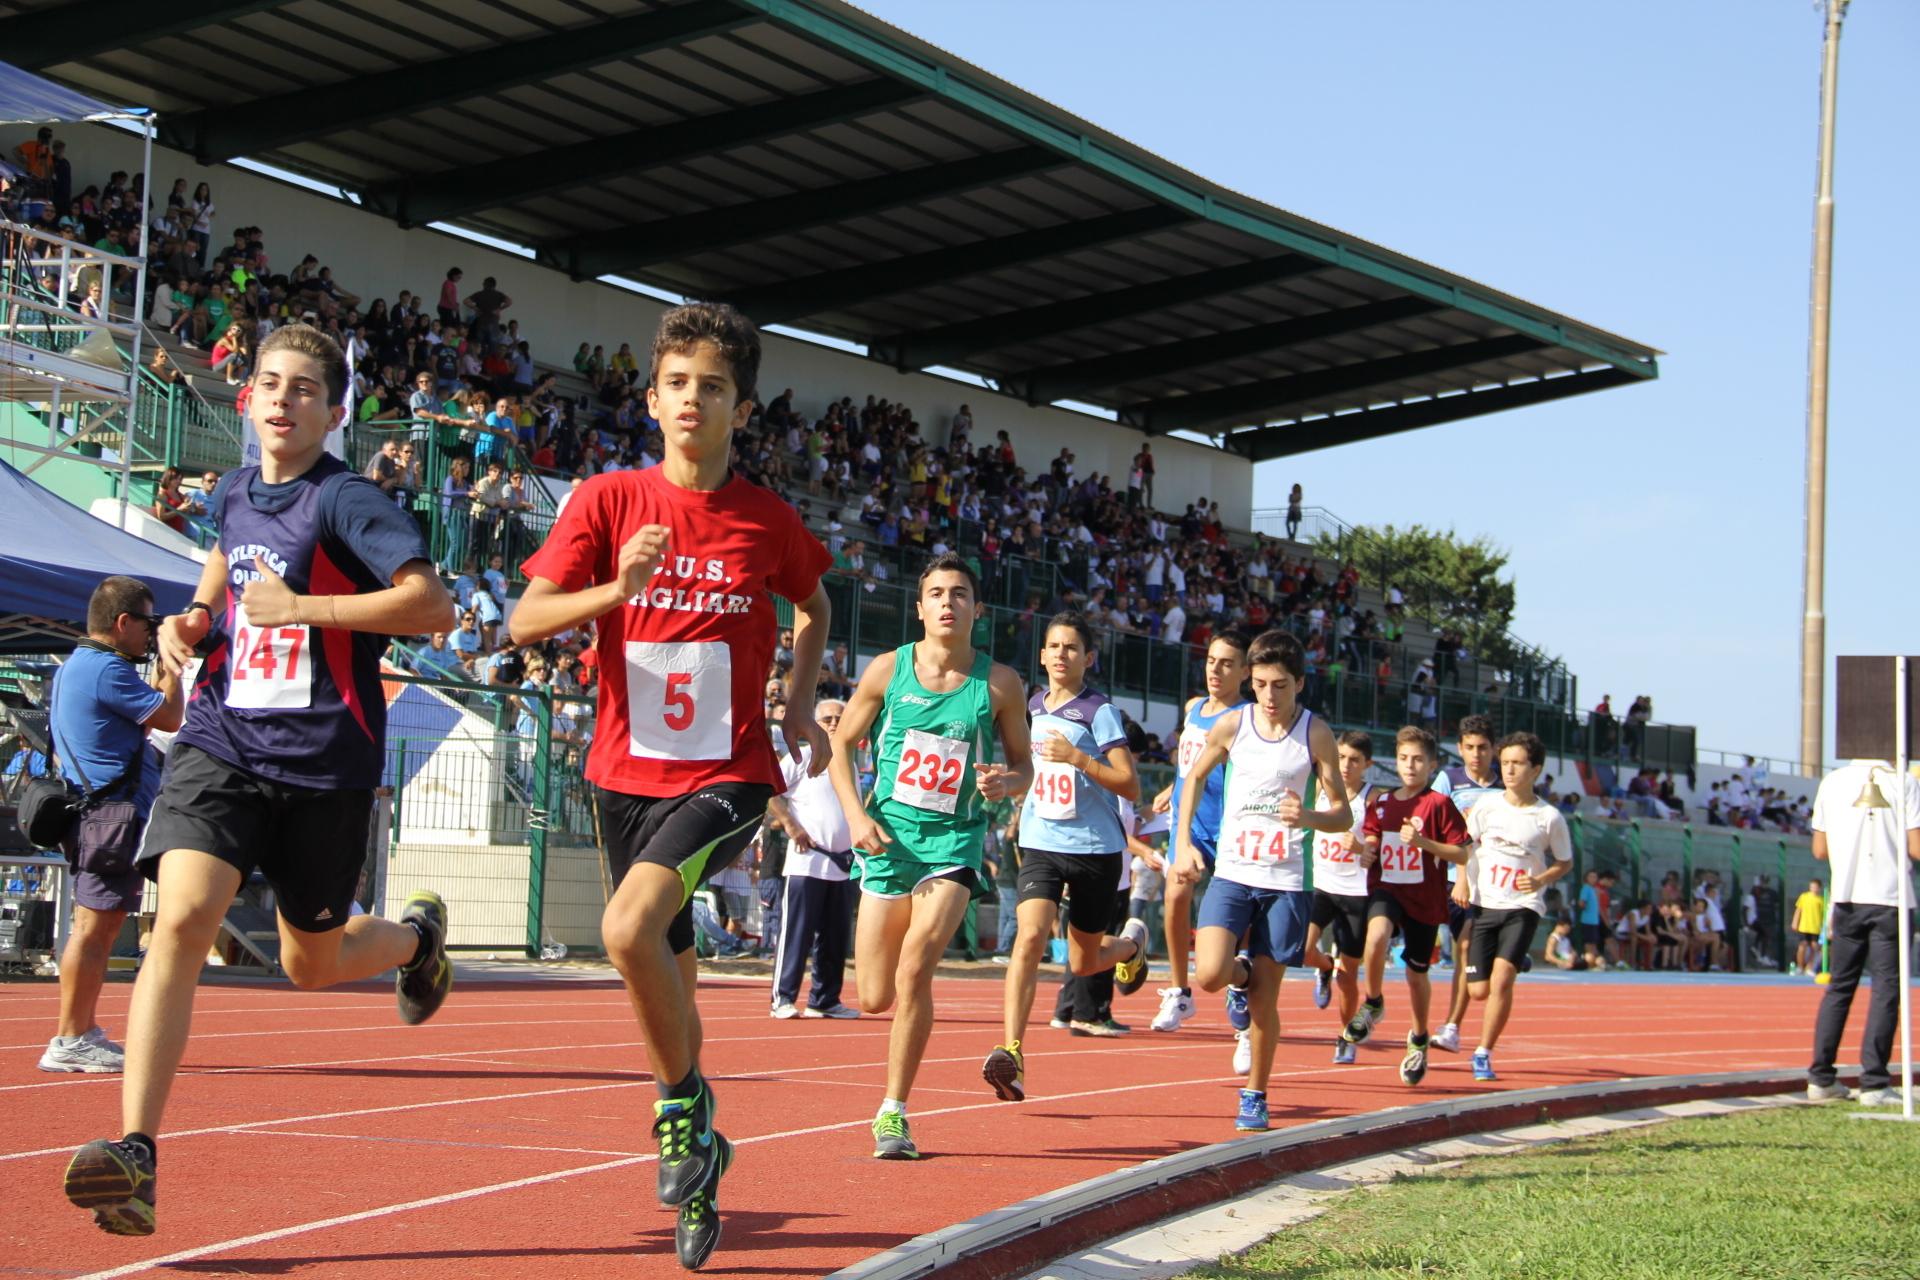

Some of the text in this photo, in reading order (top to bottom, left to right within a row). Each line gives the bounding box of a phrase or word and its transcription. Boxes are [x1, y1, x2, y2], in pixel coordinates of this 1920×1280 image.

[247, 443, 262, 460] ATL
[628, 586, 753, 614] AGLIARI
[234, 627, 305, 680] 247
[664, 673, 694, 731] 5
[910, 695, 932, 707] asics
[1180, 741, 1205, 767] 187
[897, 749, 962, 795] 232
[1034, 772, 1073, 805] 419
[1242, 804, 1280, 814] AIRON
[1236, 830, 1286, 862] 174
[1382, 845, 1421, 871] 212
